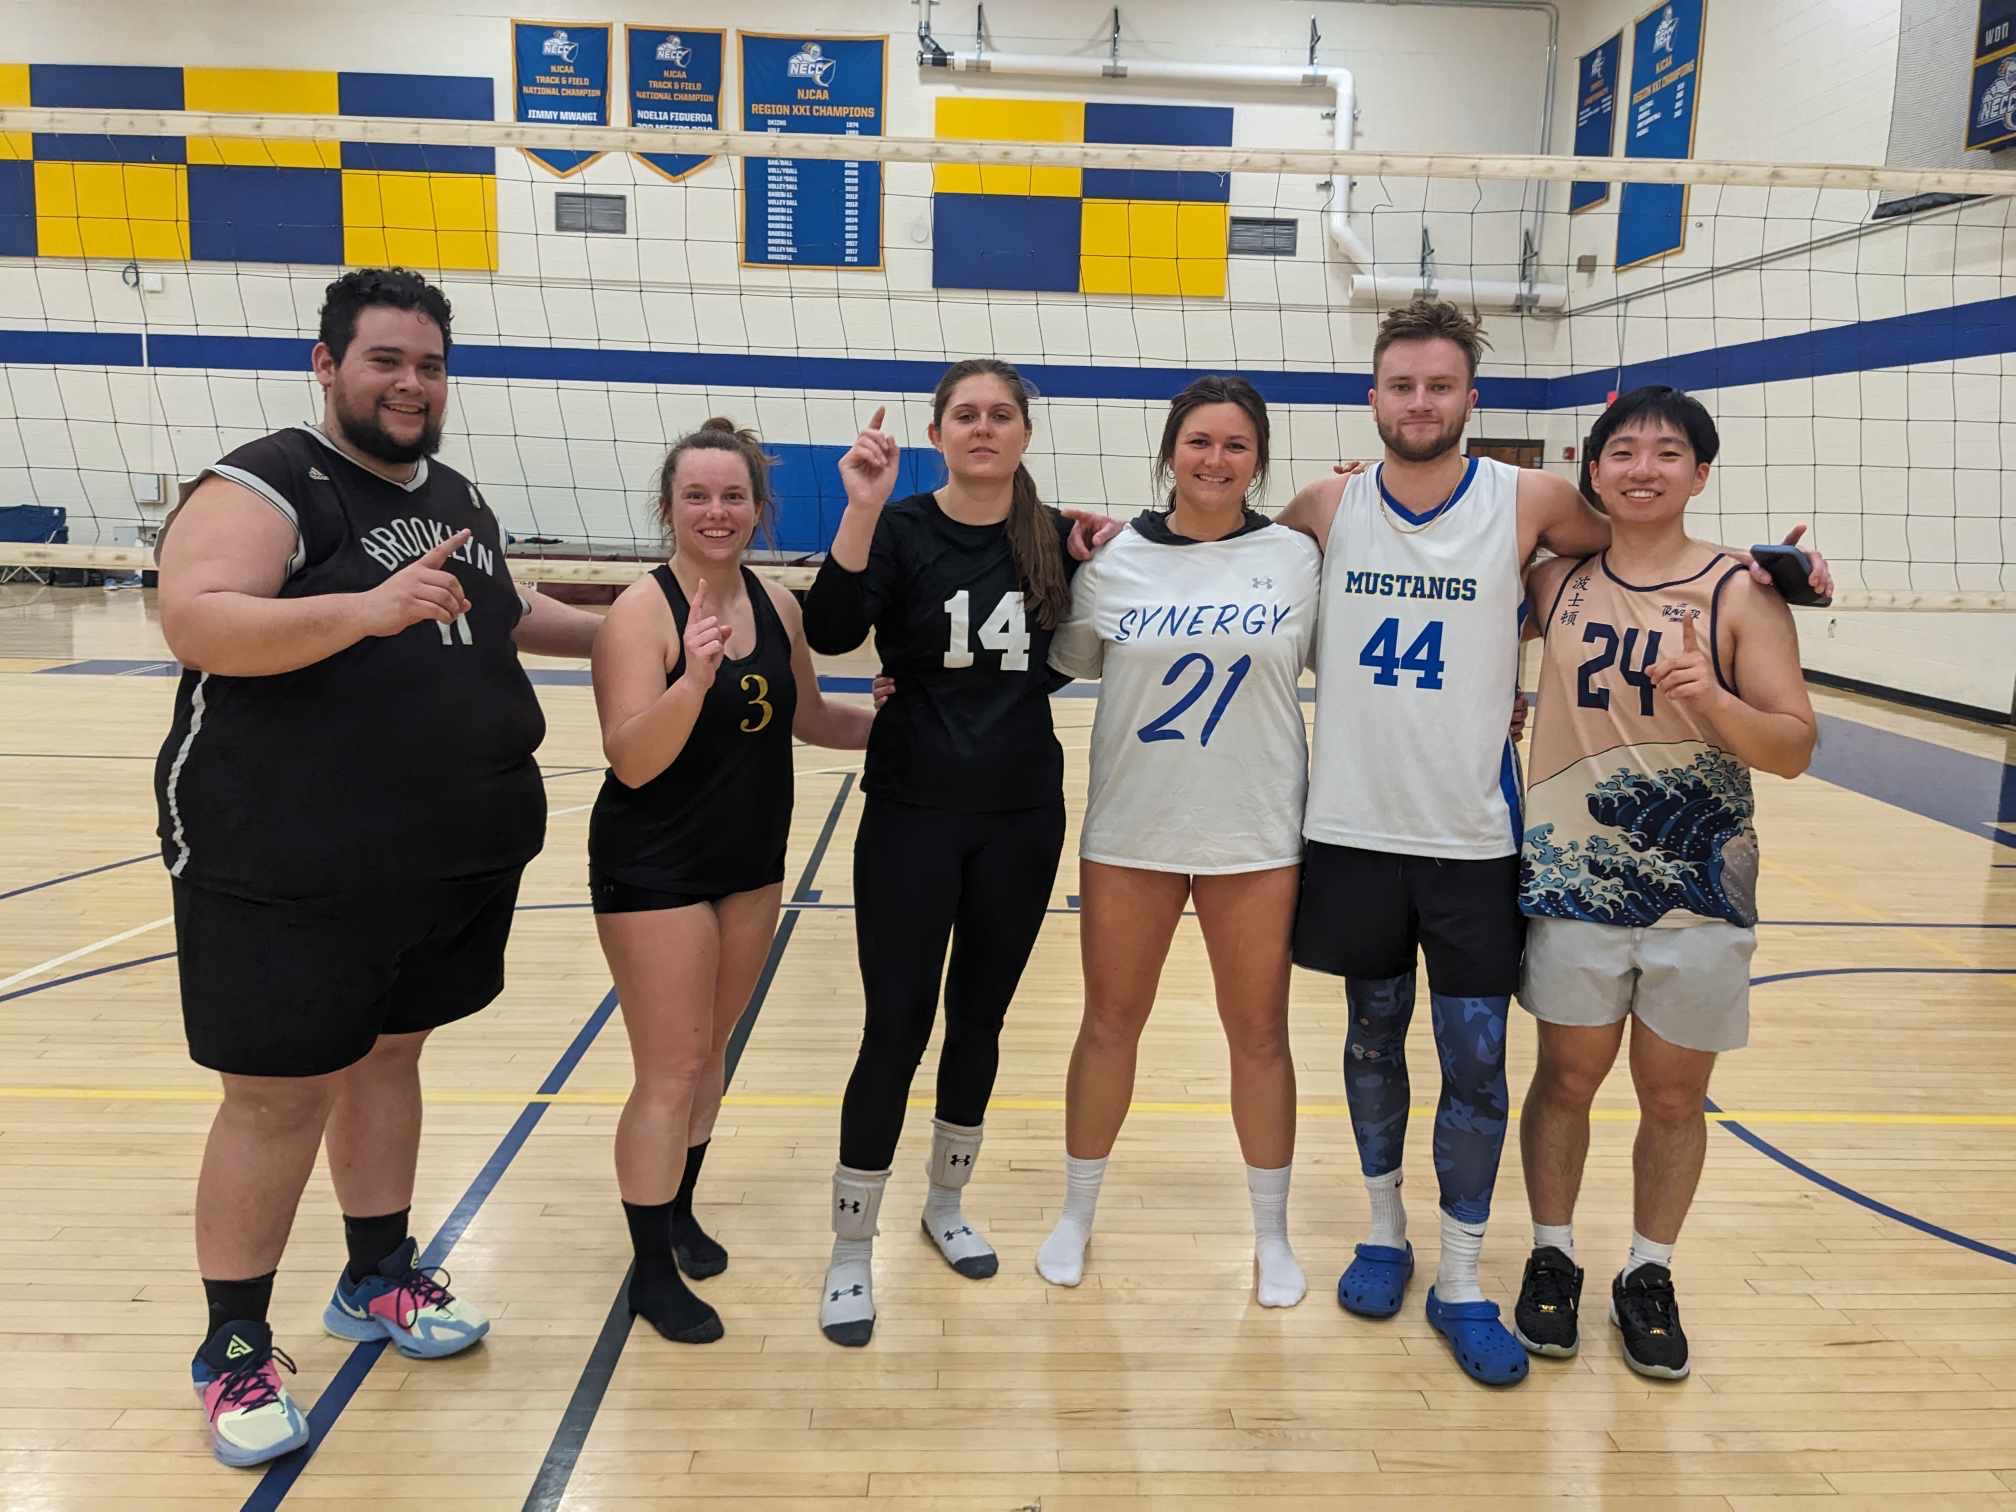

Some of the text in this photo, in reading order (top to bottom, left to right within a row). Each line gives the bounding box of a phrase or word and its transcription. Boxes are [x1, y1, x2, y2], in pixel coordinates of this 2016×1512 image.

[657, 49, 683, 60] NECC
[790, 63, 825, 75] NECC
[536, 75, 560, 84] TRACK
[568, 77, 590, 86] FIELD
[648, 80, 673, 89] TRACK
[680, 82, 702, 91] FIELD
[522, 86, 601, 97] NATIONAL CHAMPION
[636, 90, 714, 102] NATIONAL CHAMPION
[797, 89, 829, 100] NJCAA
[560, 111, 598, 121] MWANGI
[637, 110, 713, 123] NOELIA FIGUEROA
[752, 104, 790, 115] REGION
[812, 105, 875, 118] CHAMPIONS
[1345, 571, 1477, 601] MUSTANGS
[1114, 603, 1291, 642] SYNERGY
[943, 590, 1031, 671] 14
[1359, 617, 1445, 690] 44
[1577, 621, 1663, 717] 24
[739, 673, 773, 733] 3
[1137, 652, 1252, 748] 21
